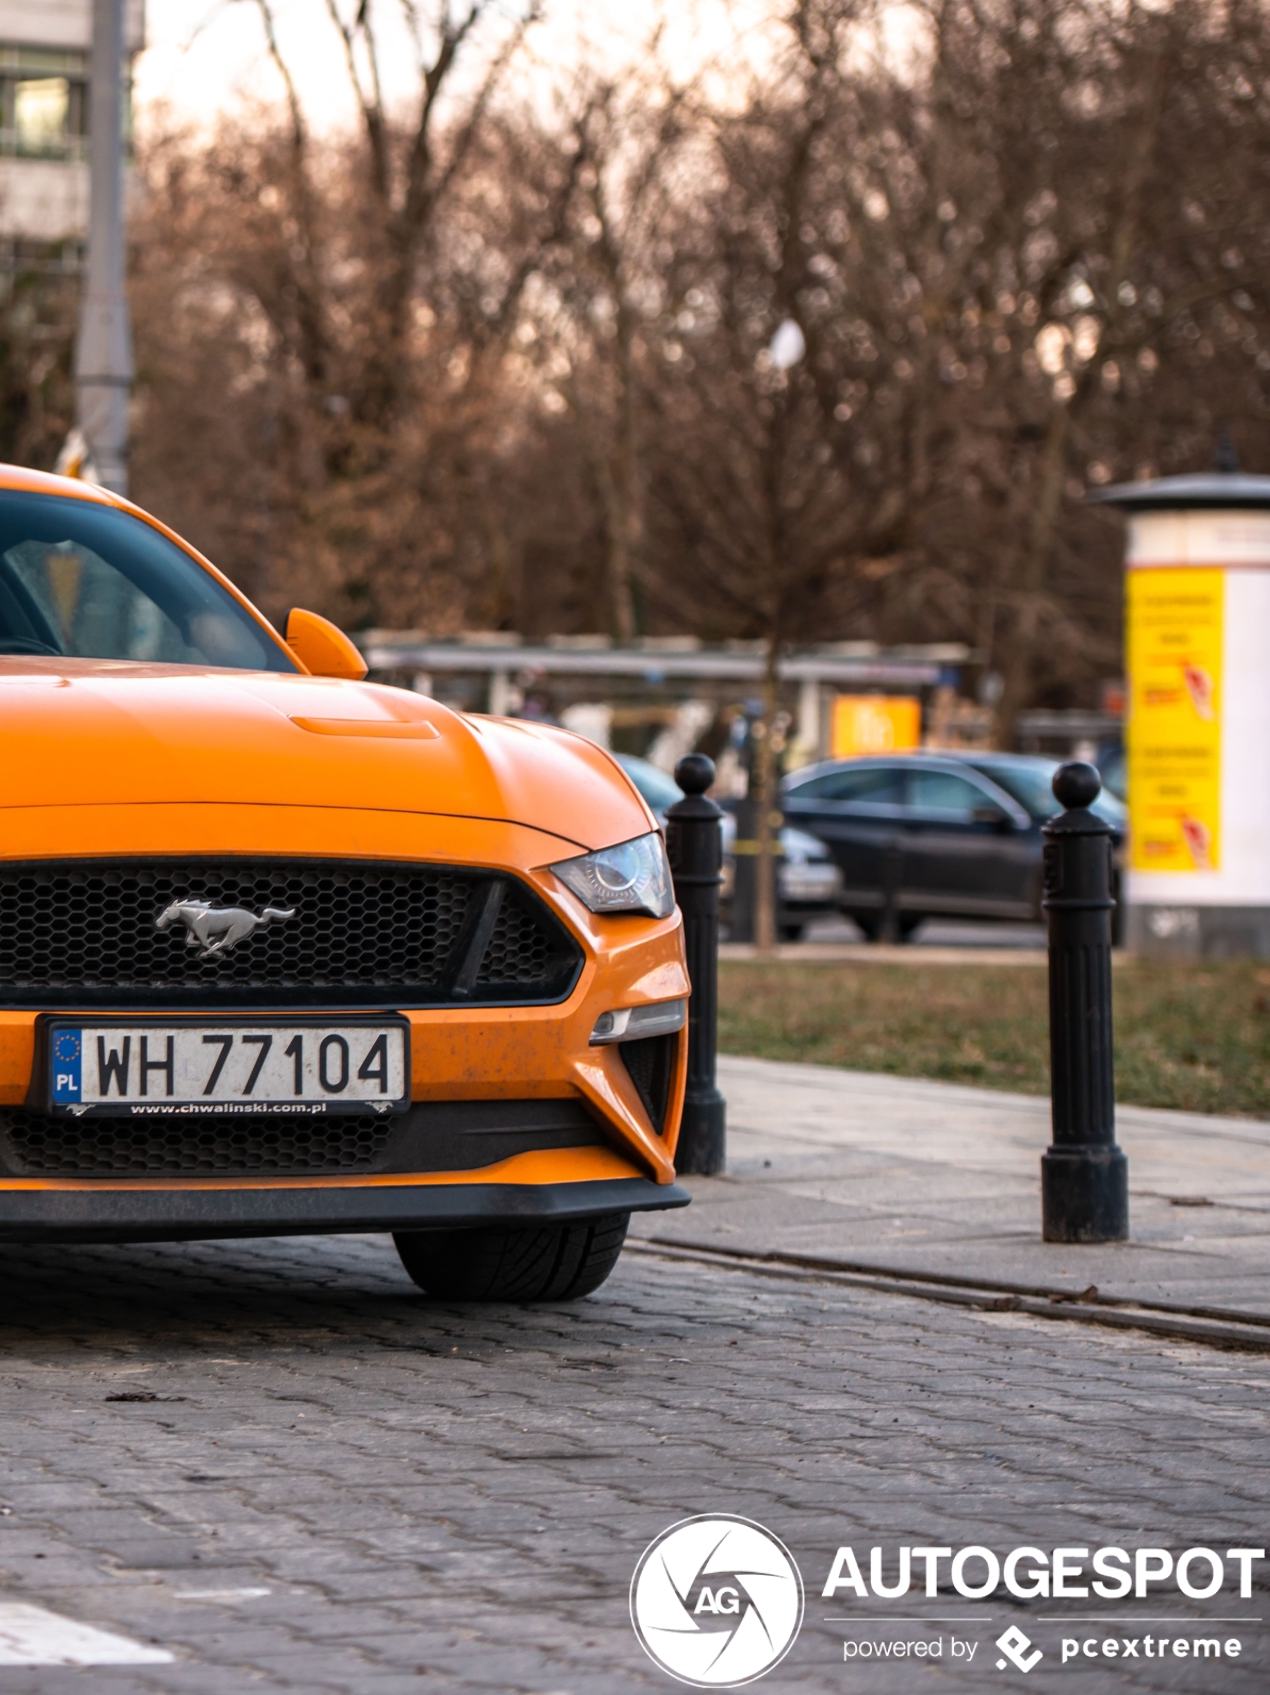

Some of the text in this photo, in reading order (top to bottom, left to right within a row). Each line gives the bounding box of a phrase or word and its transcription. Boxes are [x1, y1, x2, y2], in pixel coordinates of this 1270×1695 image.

[97, 1034, 388, 1096] WH 77104
[56, 1074, 78, 1091] PL
[130, 1103, 327, 1113] www.chwalinski.com.pl
